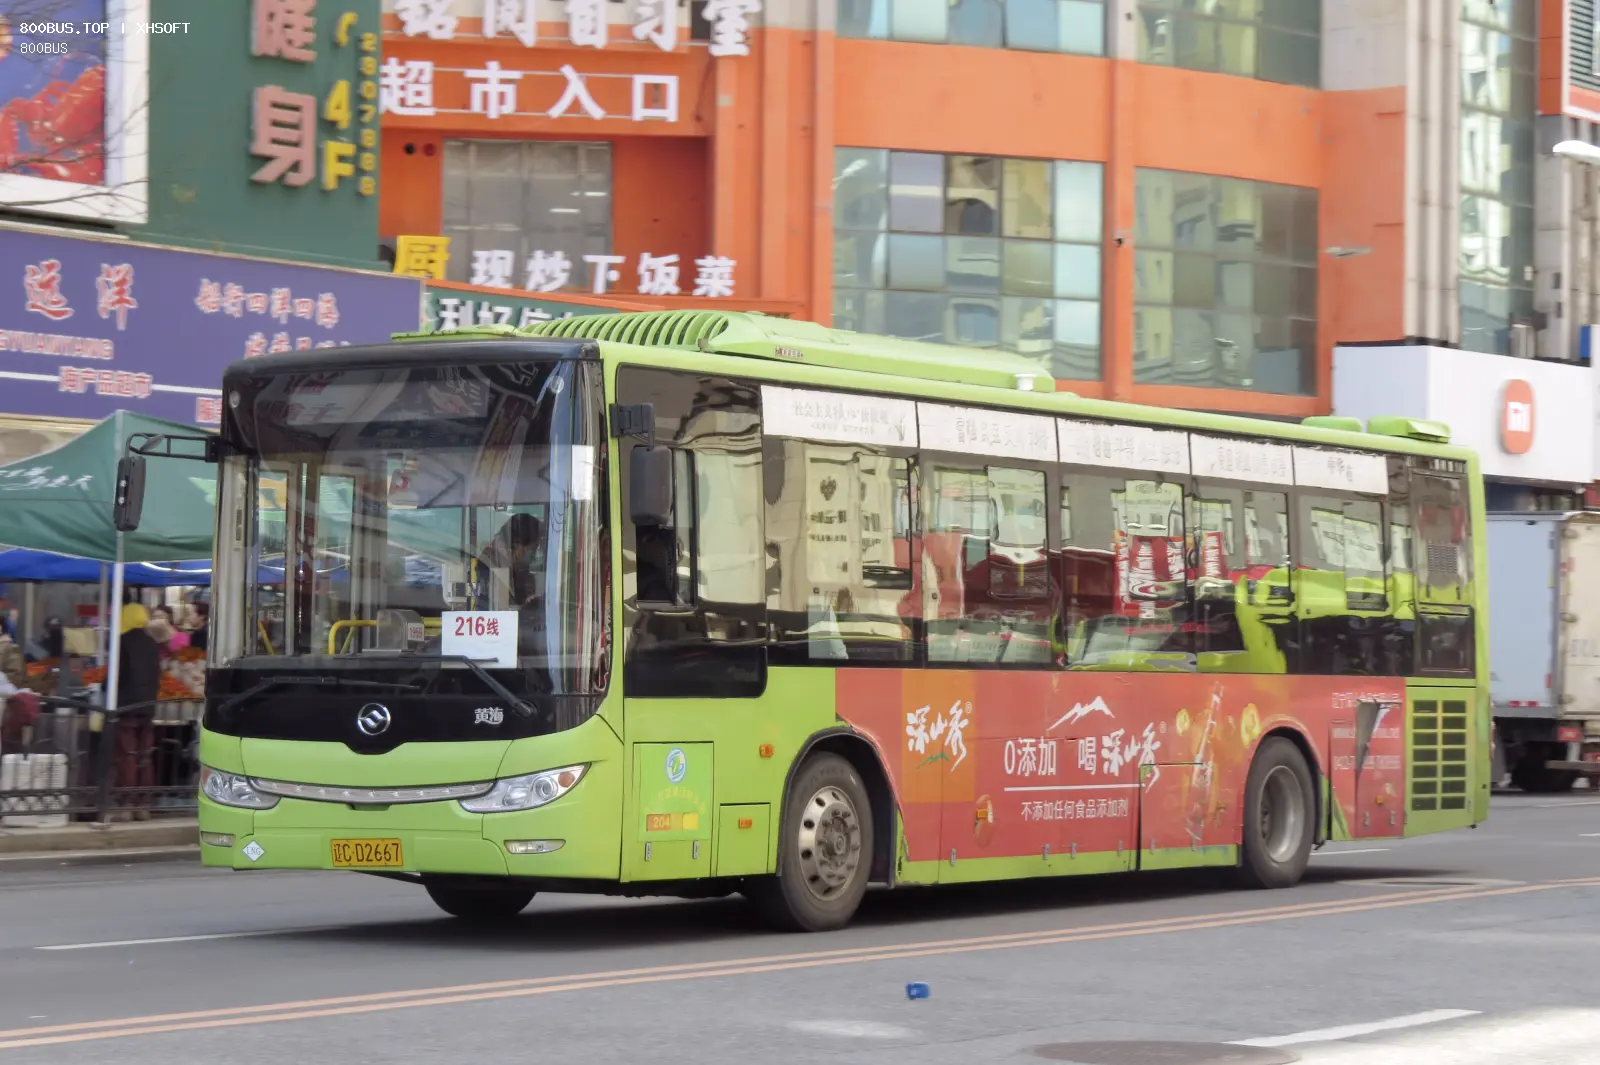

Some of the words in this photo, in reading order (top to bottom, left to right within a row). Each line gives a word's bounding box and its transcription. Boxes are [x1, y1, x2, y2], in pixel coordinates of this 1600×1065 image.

[379, 57, 680, 122] 超市入口
[469, 250, 737, 298] 现炒下饭菜
[455, 616, 499, 636] 216线
[474, 706, 504, 725] 黄海
[1021, 798, 1129, 822] 不添加任何食品添加剂
[653, 816, 670, 828] 204
